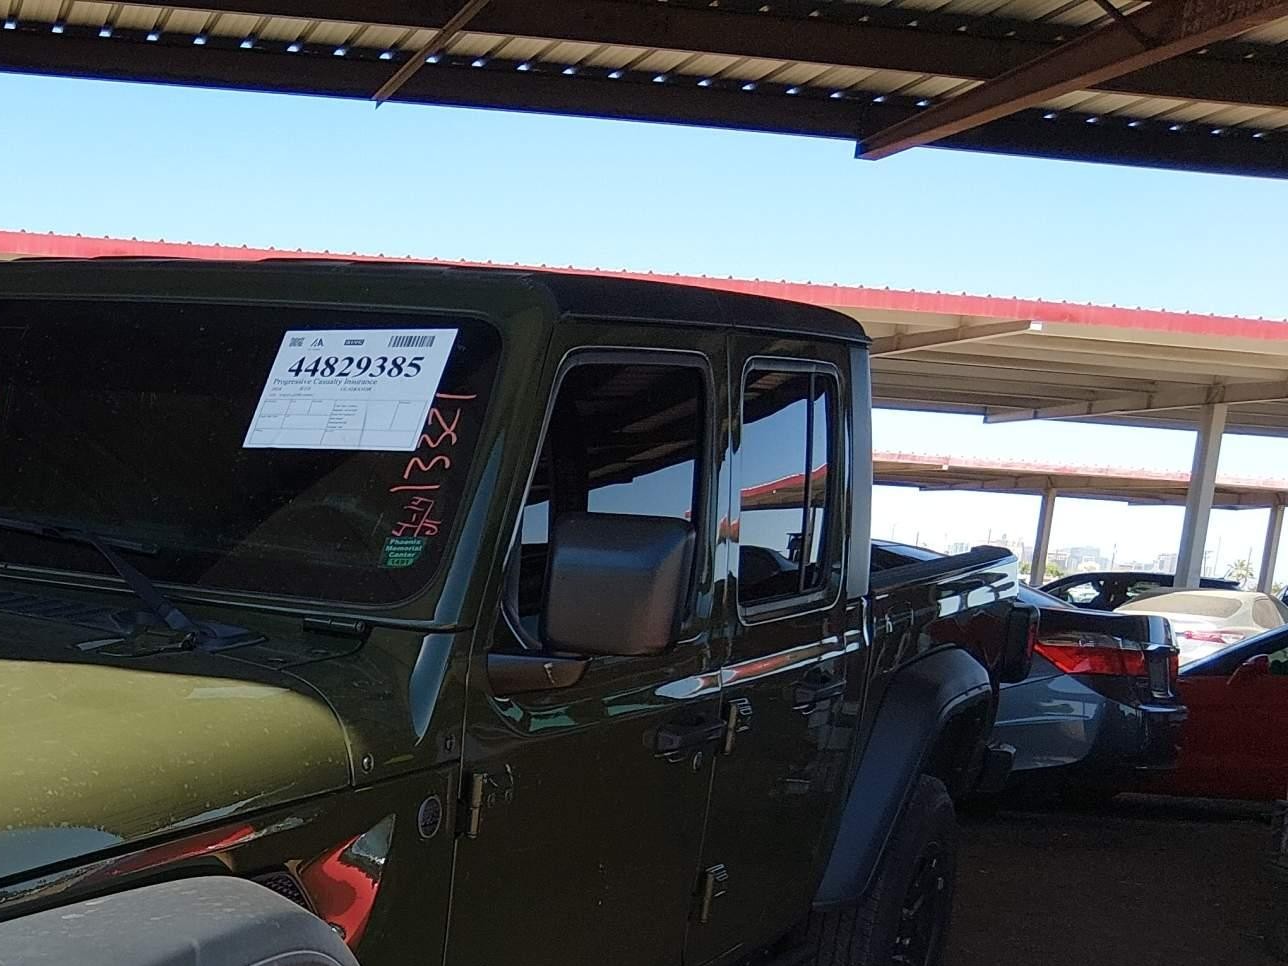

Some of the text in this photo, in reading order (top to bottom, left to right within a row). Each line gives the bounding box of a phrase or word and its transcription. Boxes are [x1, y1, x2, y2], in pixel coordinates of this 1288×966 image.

[287, 355, 425, 378] 44829385
[273, 378, 312, 386] Progressive
[313, 378, 342, 386] Casualty
